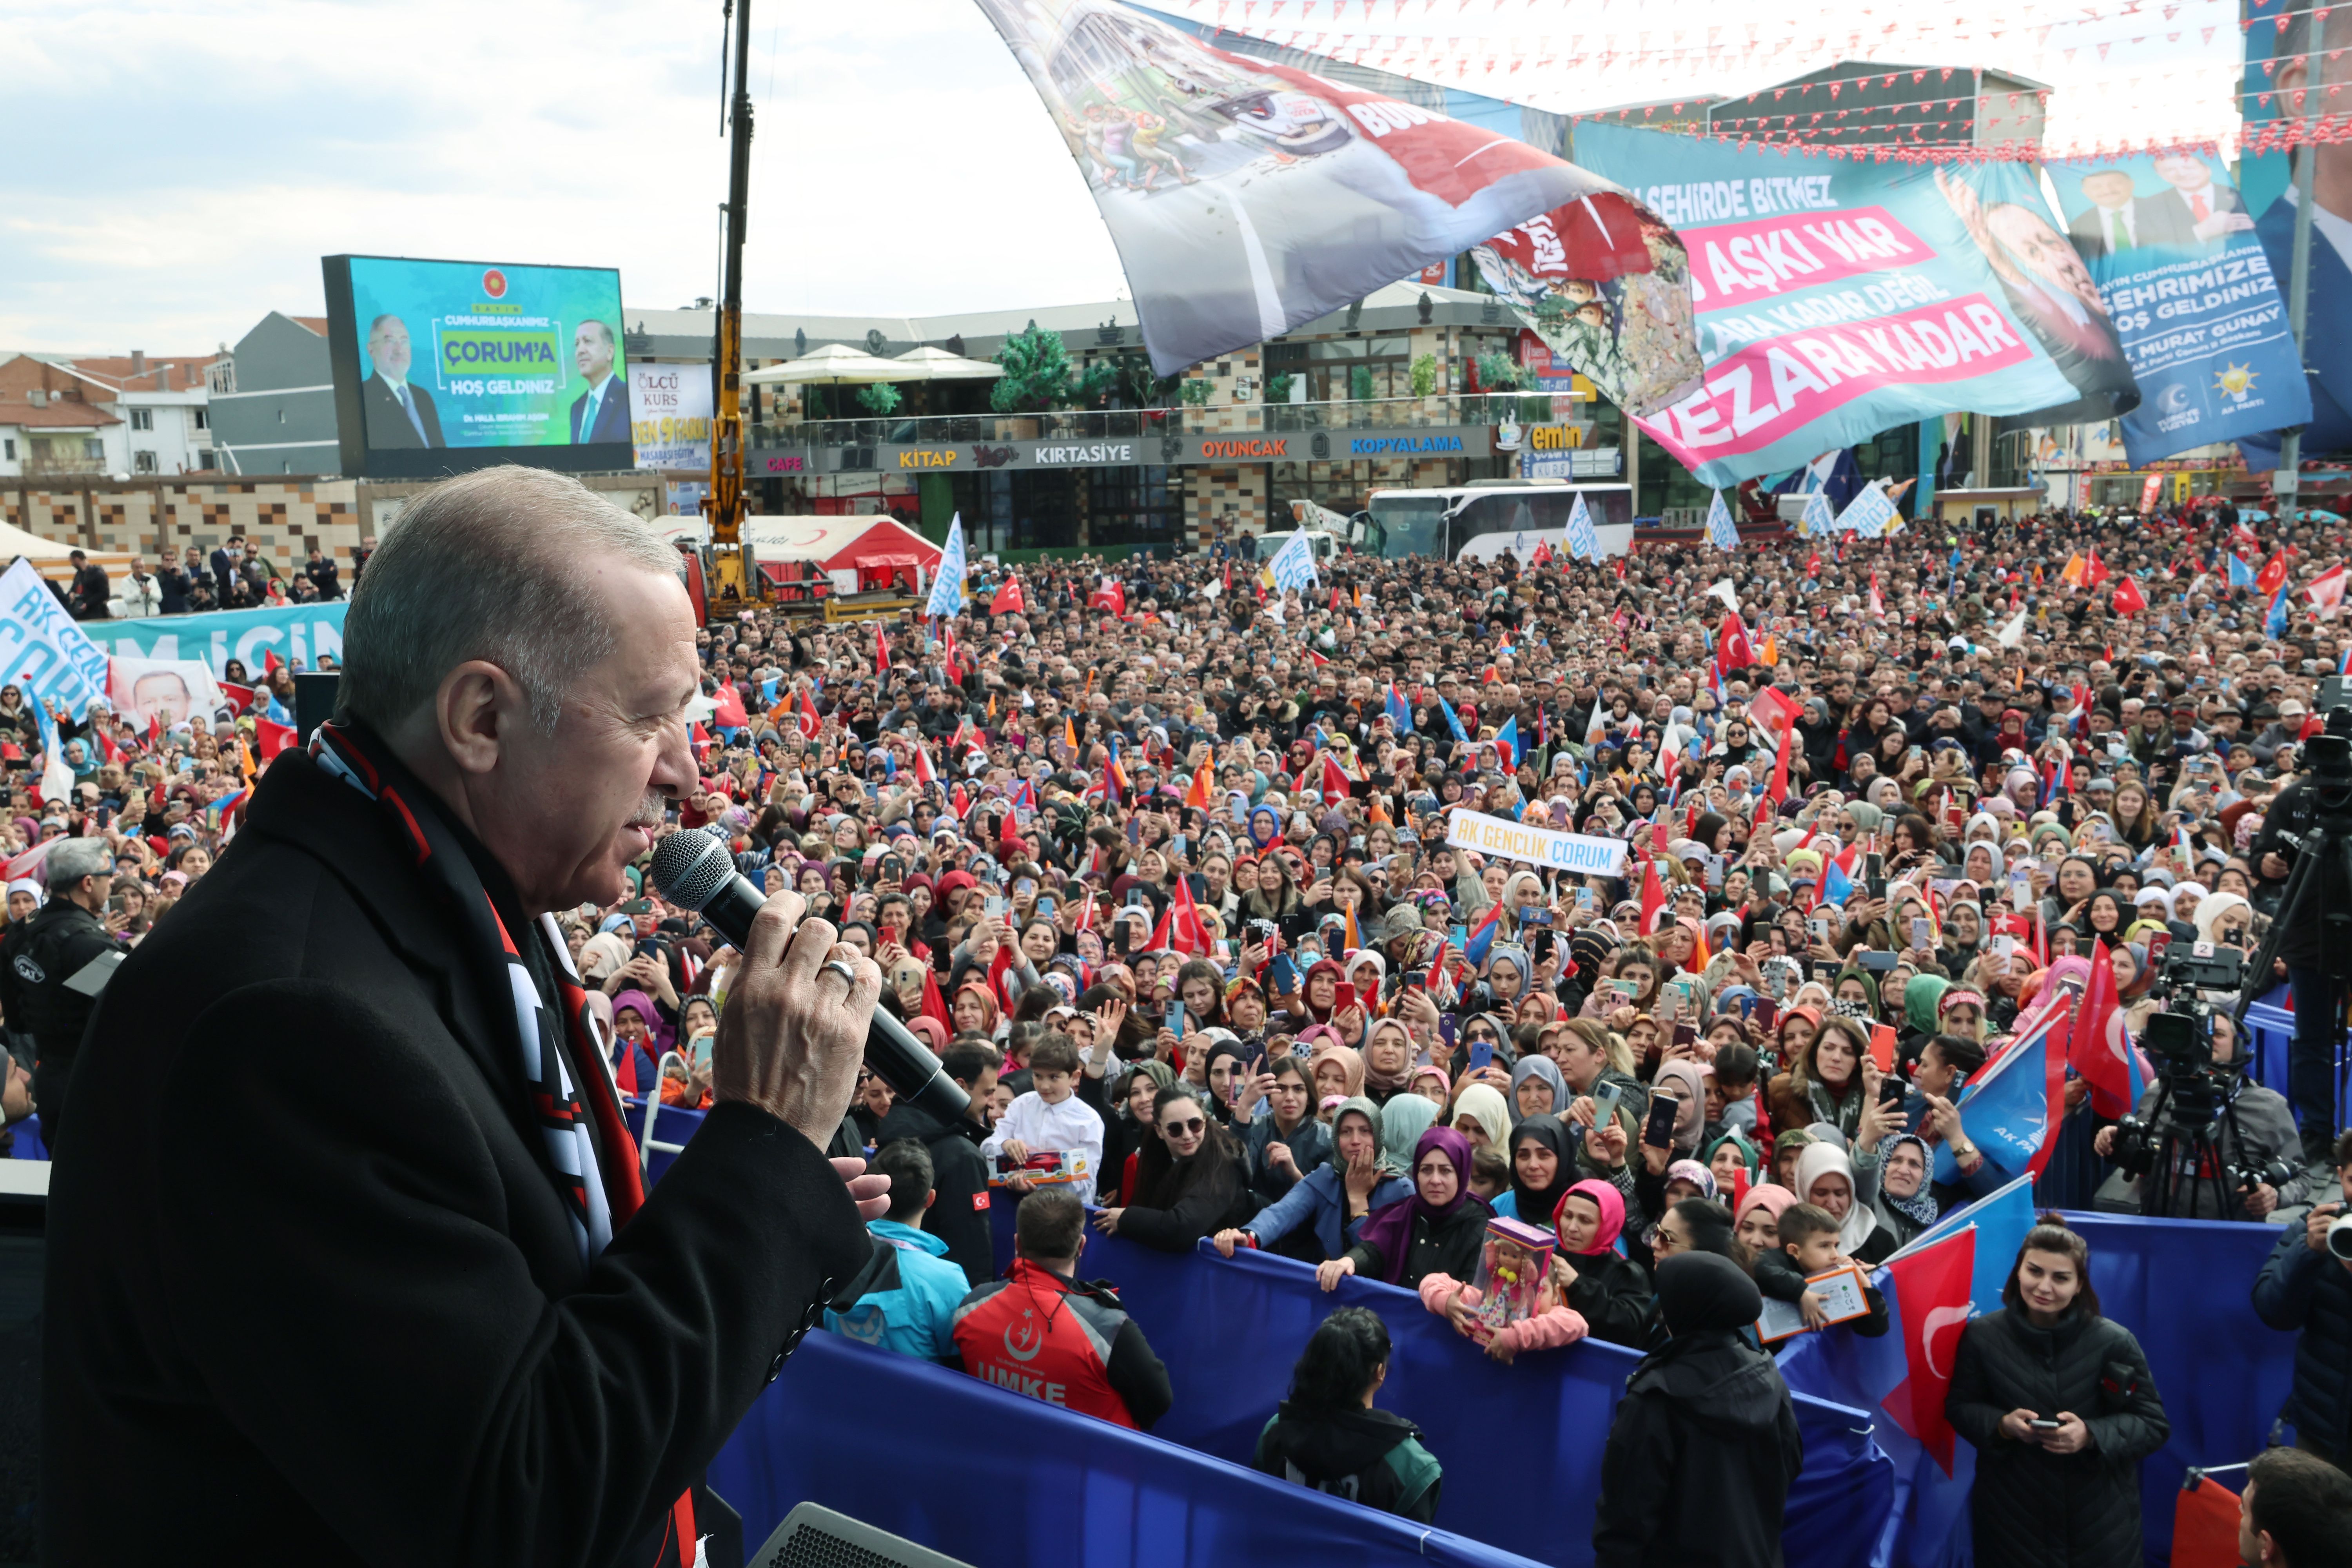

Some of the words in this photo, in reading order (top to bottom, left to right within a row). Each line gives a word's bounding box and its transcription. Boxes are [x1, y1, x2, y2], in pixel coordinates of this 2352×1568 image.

[1750, 175, 1838, 214] BİTMEZ
[1705, 228, 1826, 296] AŞKI
[1802, 217, 1914, 263] VAR
[1767, 290, 1879, 330] KADAR
[2111, 311, 2151, 333] OŞ
[1860, 303, 2019, 372] KADAR
[2138, 329, 2206, 358] MURAT
[451, 379, 484, 397] HOŞ
[638, 372, 679, 389] ÖLÇÜ
[644, 394, 678, 406] KURS
[661, 416, 674, 443] 9
[1532, 423, 1582, 450] emin
[1035, 443, 1131, 464] KIRTASİYE
[1201, 439, 1287, 458] OYUNCAK
[1350, 436, 1463, 453] KOPYALAMA
[767, 457, 804, 471] CAFE
[900, 449, 956, 468] KİTAP
[1538, 464, 1566, 477] KURS
[12, 586, 59, 635] AK
[1457, 818, 1477, 843] AK
[1552, 840, 1612, 869] ÇORUM
[2200, 944, 2208, 953] 2
[1993, 1127, 2018, 1142] AK
[2016, 1140, 2036, 1154] PA
